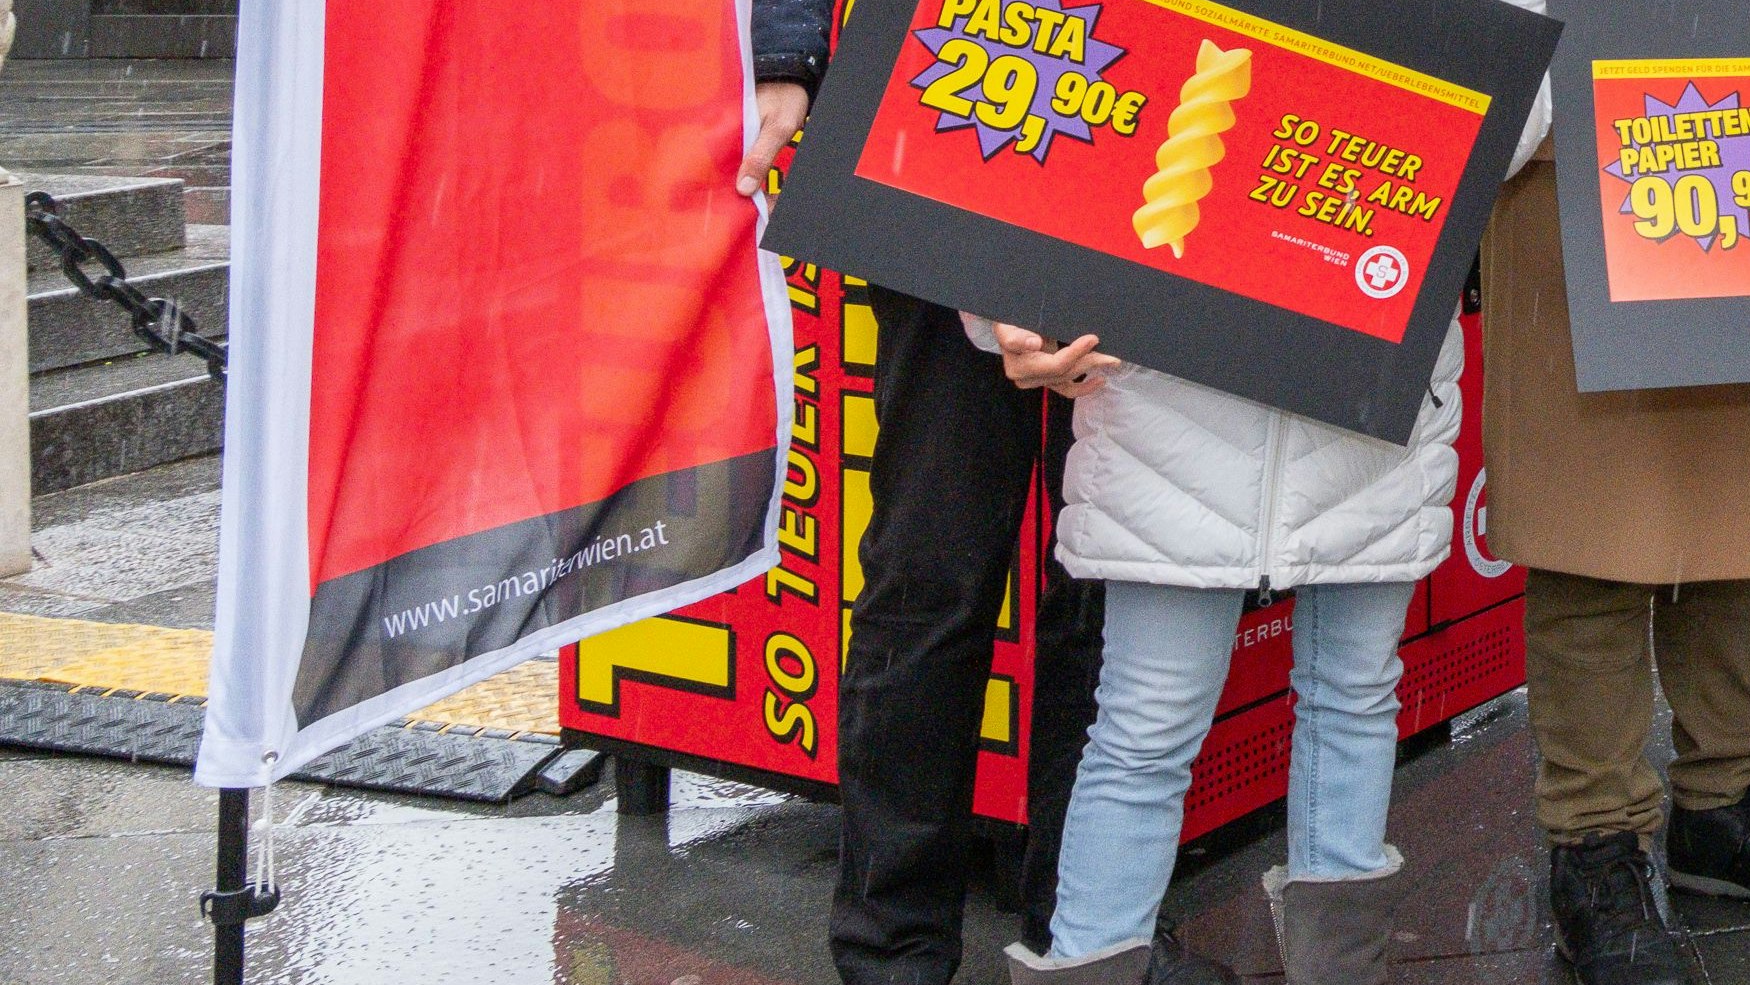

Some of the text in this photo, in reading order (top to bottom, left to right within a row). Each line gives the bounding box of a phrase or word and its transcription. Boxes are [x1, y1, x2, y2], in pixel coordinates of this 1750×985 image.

[1272, 110, 1424, 182] SO TEUER
[1619, 141, 1721, 176] PAPIER
[1248, 172, 1381, 237] ZU SEIN.
[1260, 142, 1441, 222] IST ES, ARM
[1270, 230, 1350, 261] SAMARITERBUND
[1322, 254, 1348, 267] WIEN
[764, 633, 819, 759] SO
